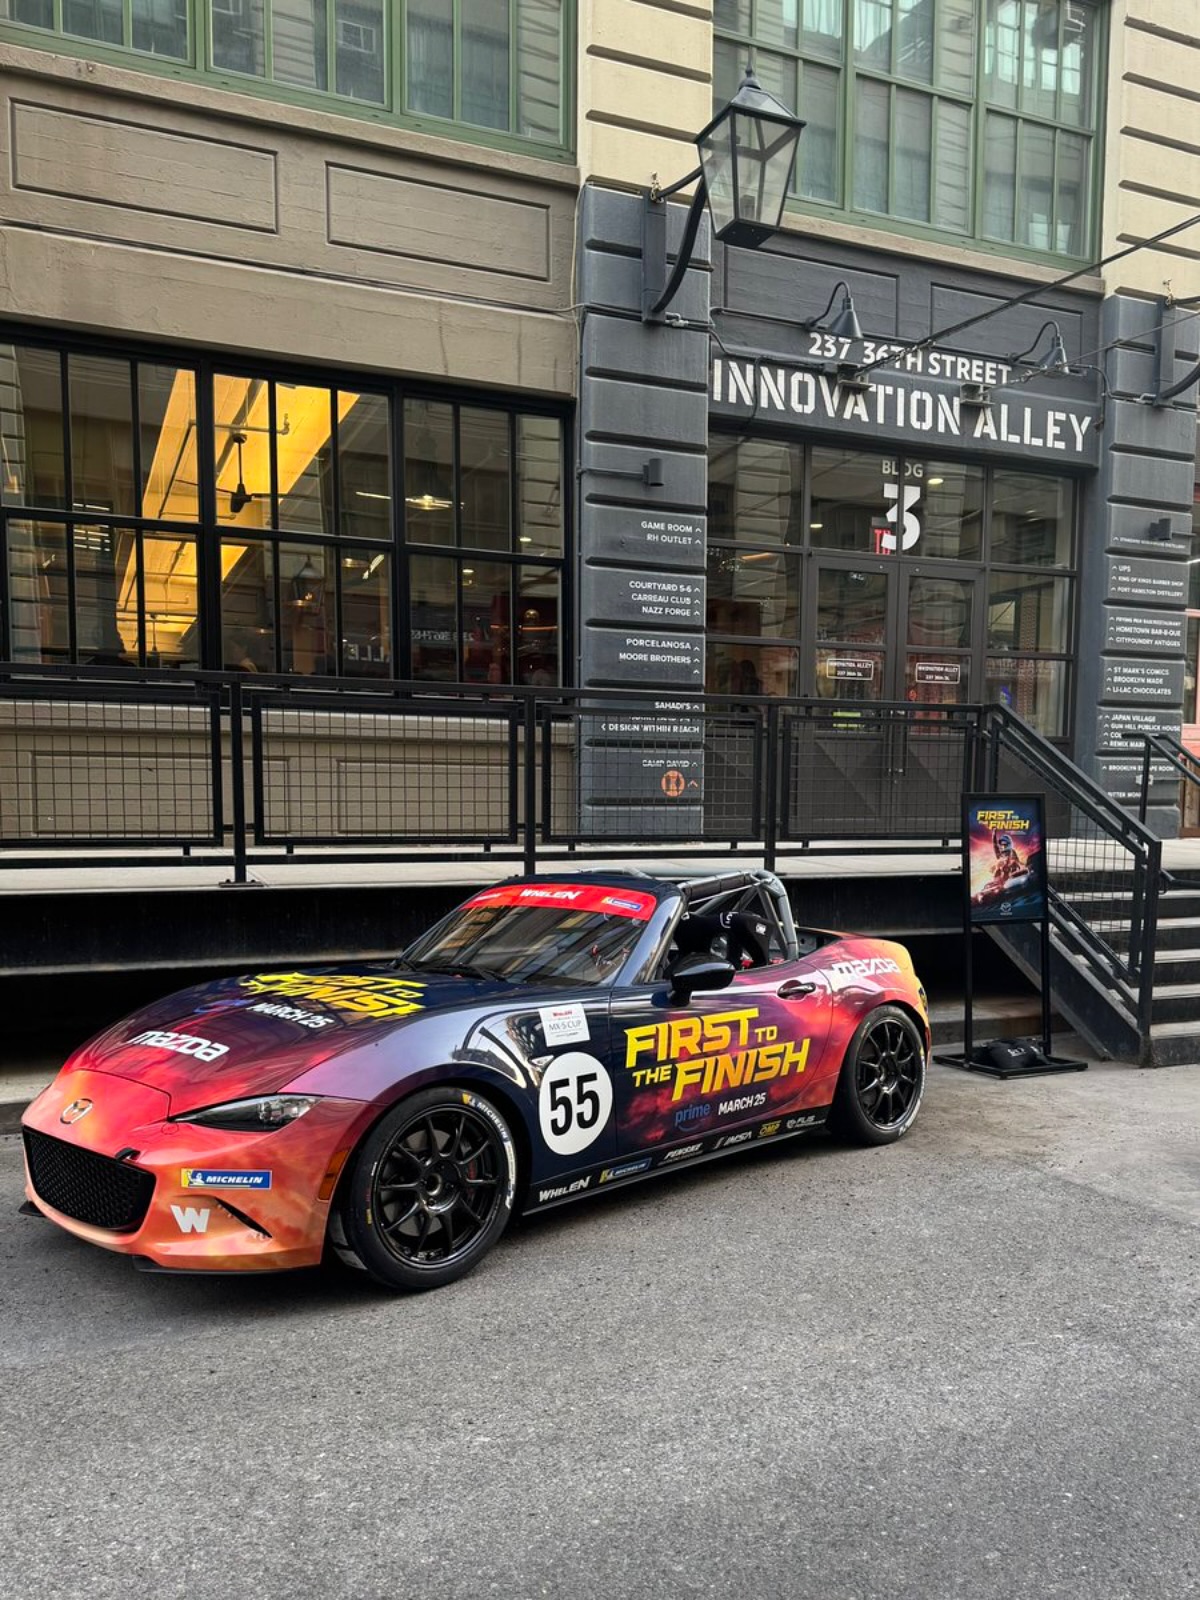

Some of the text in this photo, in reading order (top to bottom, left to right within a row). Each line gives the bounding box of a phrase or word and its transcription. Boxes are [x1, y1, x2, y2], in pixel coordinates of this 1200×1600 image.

[808, 331, 1013, 386] 237 36TH STREET
[712, 358, 1092, 453] INNOVATION ALLEY
[880, 482, 922, 551] 3
[641, 521, 692, 533] GAME ROOM
[646, 534, 692, 544] RH OUTLET
[1118, 565, 1132, 573] UPS
[628, 581, 692, 593] COURTYARD 5-6
[631, 593, 692, 605] CARREAU CLUB
[642, 606, 691, 616] NAZZ FORGE
[1115, 626, 1150, 634] HOMETOWN
[626, 639, 691, 650] PORCELANOSA
[1154, 639, 1181, 647] ANTIQUES
[619, 652, 691, 664] MOORE BROTHERS
[1113, 666, 1170, 676] ST MARK'S COMICS
[1112, 676, 1164, 685] BROOKLYN MADE
[1112, 686, 1172, 696] LI-LAC CHOCOLATES
[1111, 714, 1156, 723] JAPAN VILLAGE
[608, 723, 700, 733] DESIGN WITHIN REACH
[1137, 724, 1161, 732] PUBLICK
[1109, 740, 1128, 748] REMIX
[976, 810, 1014, 821] FIRST
[988, 819, 1030, 830] FINISH
[519, 889, 584, 900] WHELEN
[245, 1002, 311, 1022] MARCH
[301, 1014, 335, 1029] 25
[548, 1019, 582, 1031] MX-5 CUP
[623, 1007, 778, 1069] FIRST TO
[632, 1038, 811, 1102] THE FINISH
[549, 1072, 601, 1137] 55
[674, 1092, 767, 1126] prime MARCH 25
[476, 1101, 509, 1139] MICHELIN
[205, 1175, 264, 1184] MICHELIN
[539, 1176, 592, 1202] WHELEN
[169, 1204, 211, 1233] W
